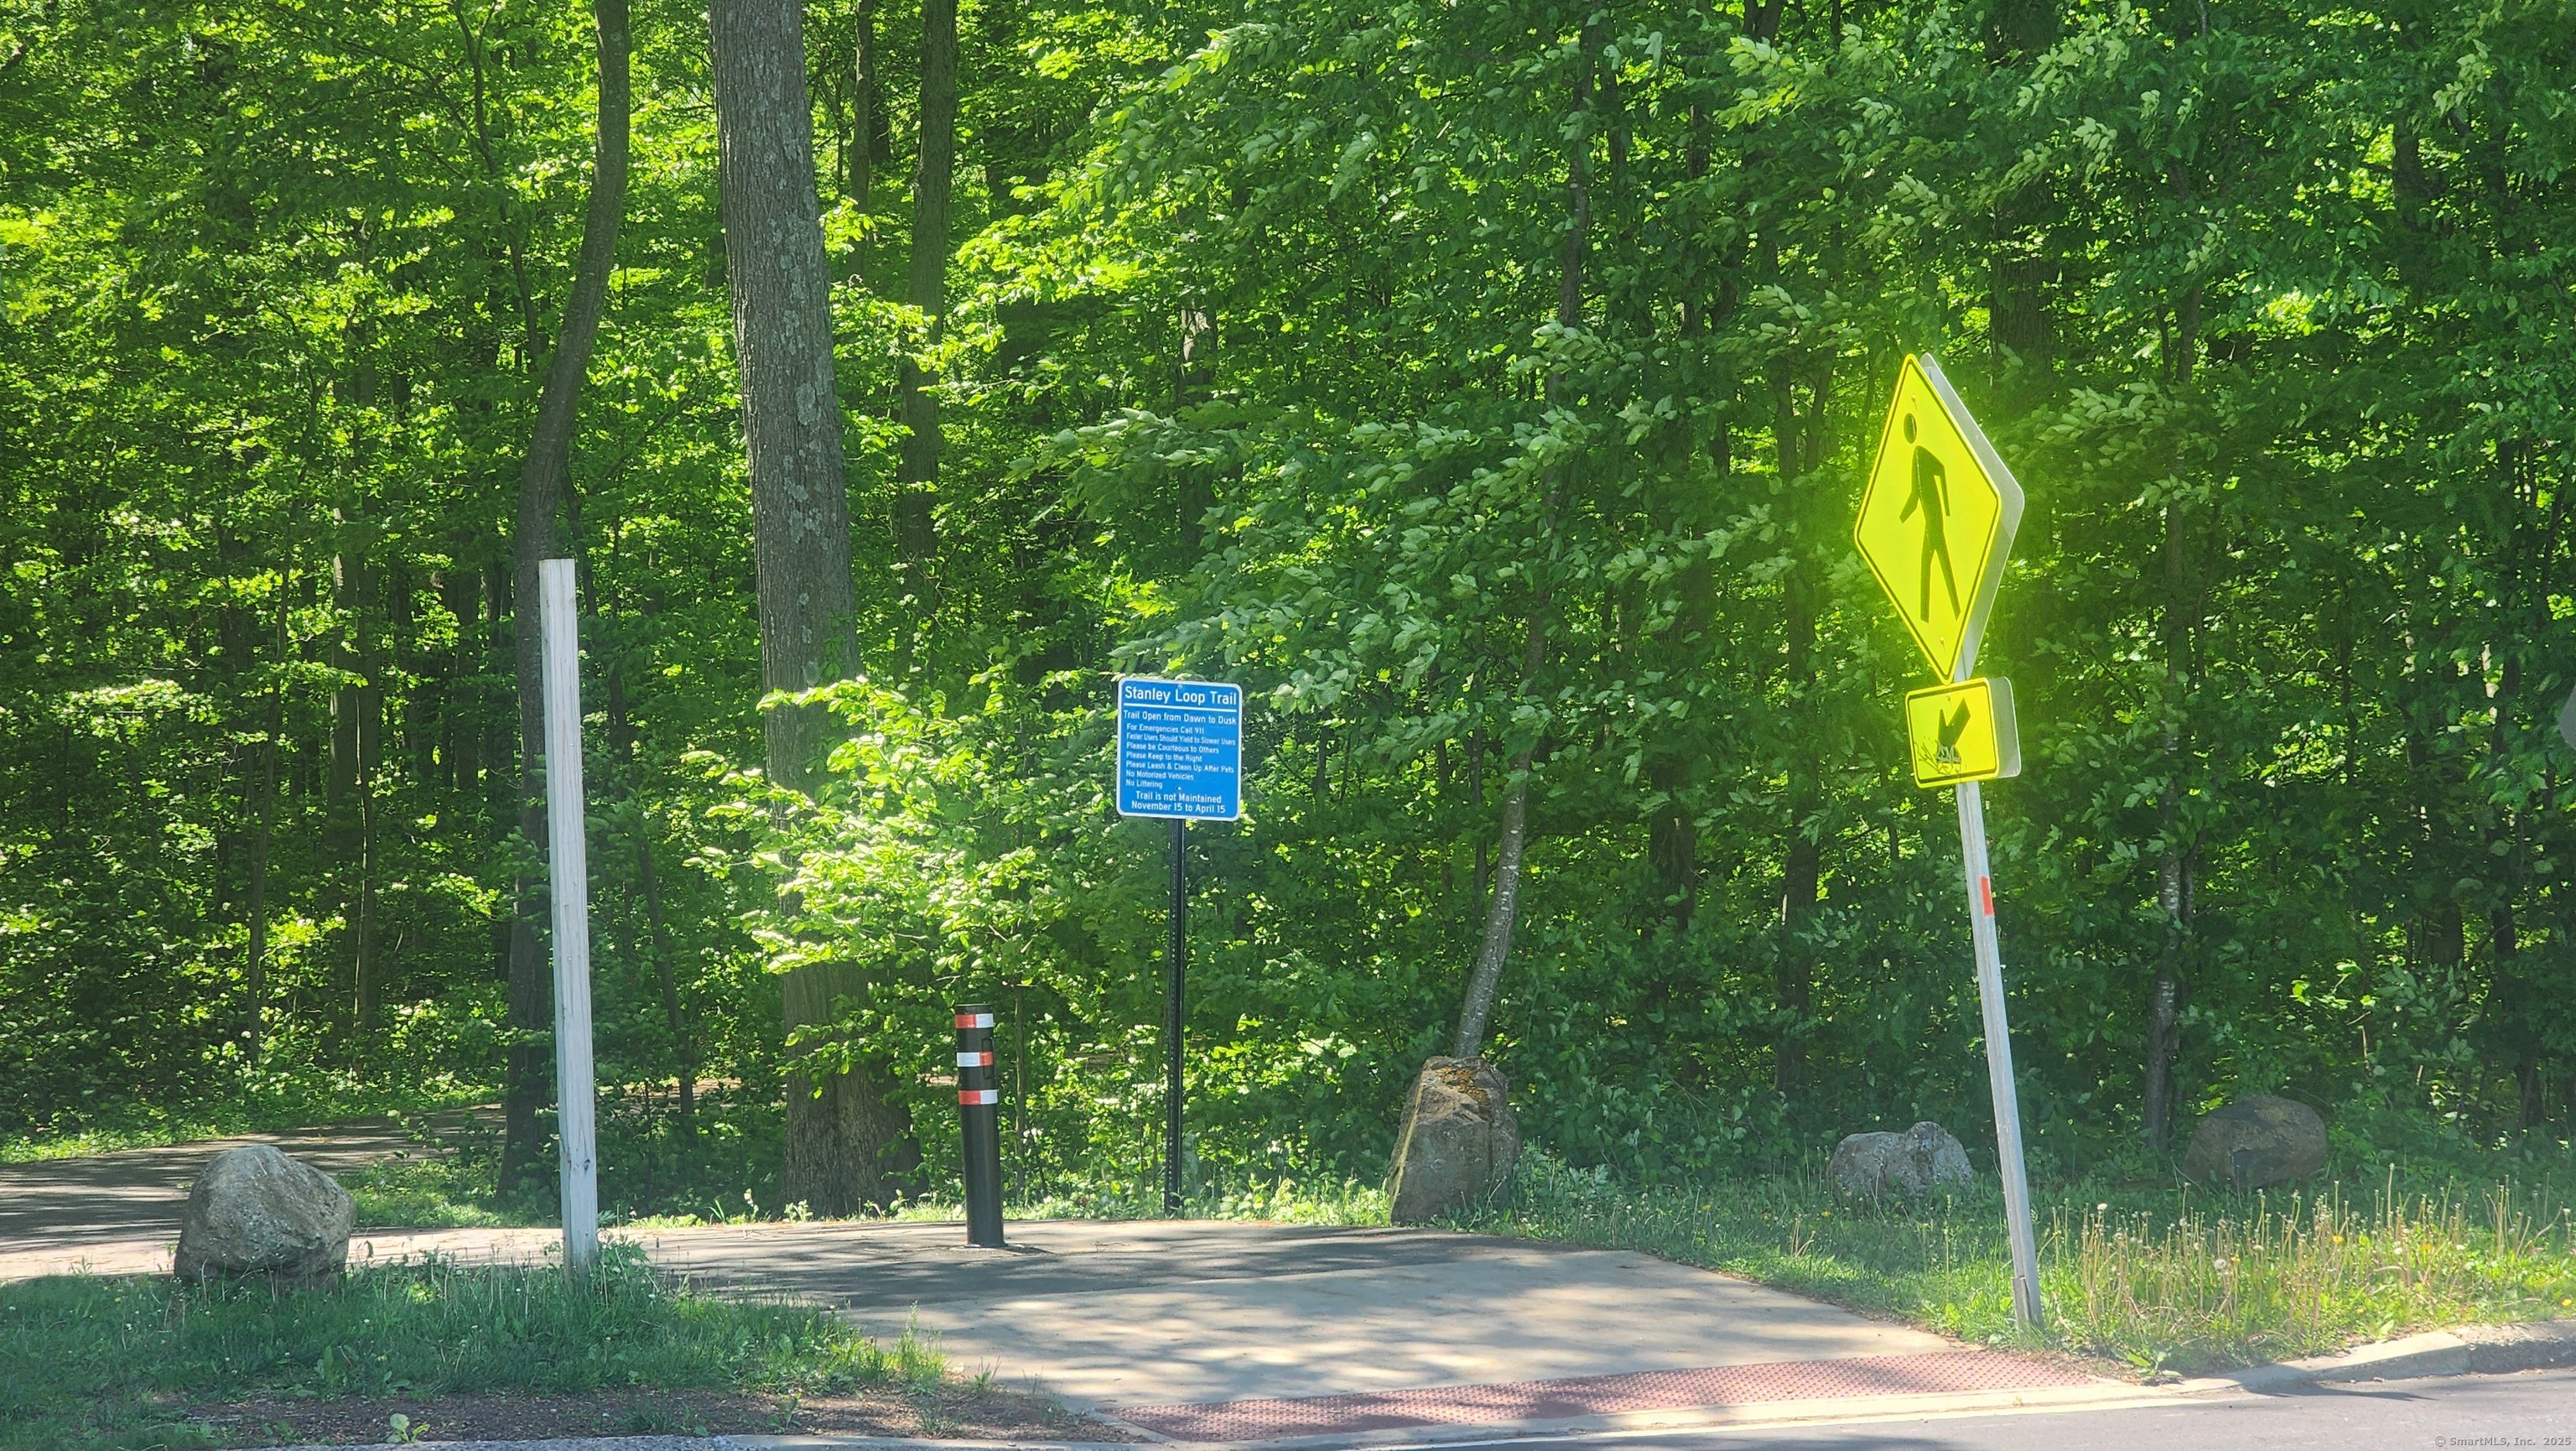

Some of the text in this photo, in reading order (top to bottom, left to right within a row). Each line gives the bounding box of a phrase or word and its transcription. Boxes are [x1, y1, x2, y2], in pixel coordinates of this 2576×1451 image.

[1125, 686, 1236, 705] Stanley Loop Trail
[1124, 710, 1140, 719] Trail
[1142, 711, 1161, 721] Open
[1164, 713, 1181, 721] from
[1184, 714, 1206, 723] Dawn
[1218, 716, 1237, 725] Dusk
[1140, 725, 1178, 733] Emergencies
[1158, 744, 1189, 752] Courteous
[1186, 755, 1202, 763] Right
[1135, 791, 1153, 799] Trail
[1179, 793, 1221, 803] Maintained
[1132, 801, 1171, 810] November
[1196, 804, 1214, 813] April
[1218, 804, 1225, 813] 15
